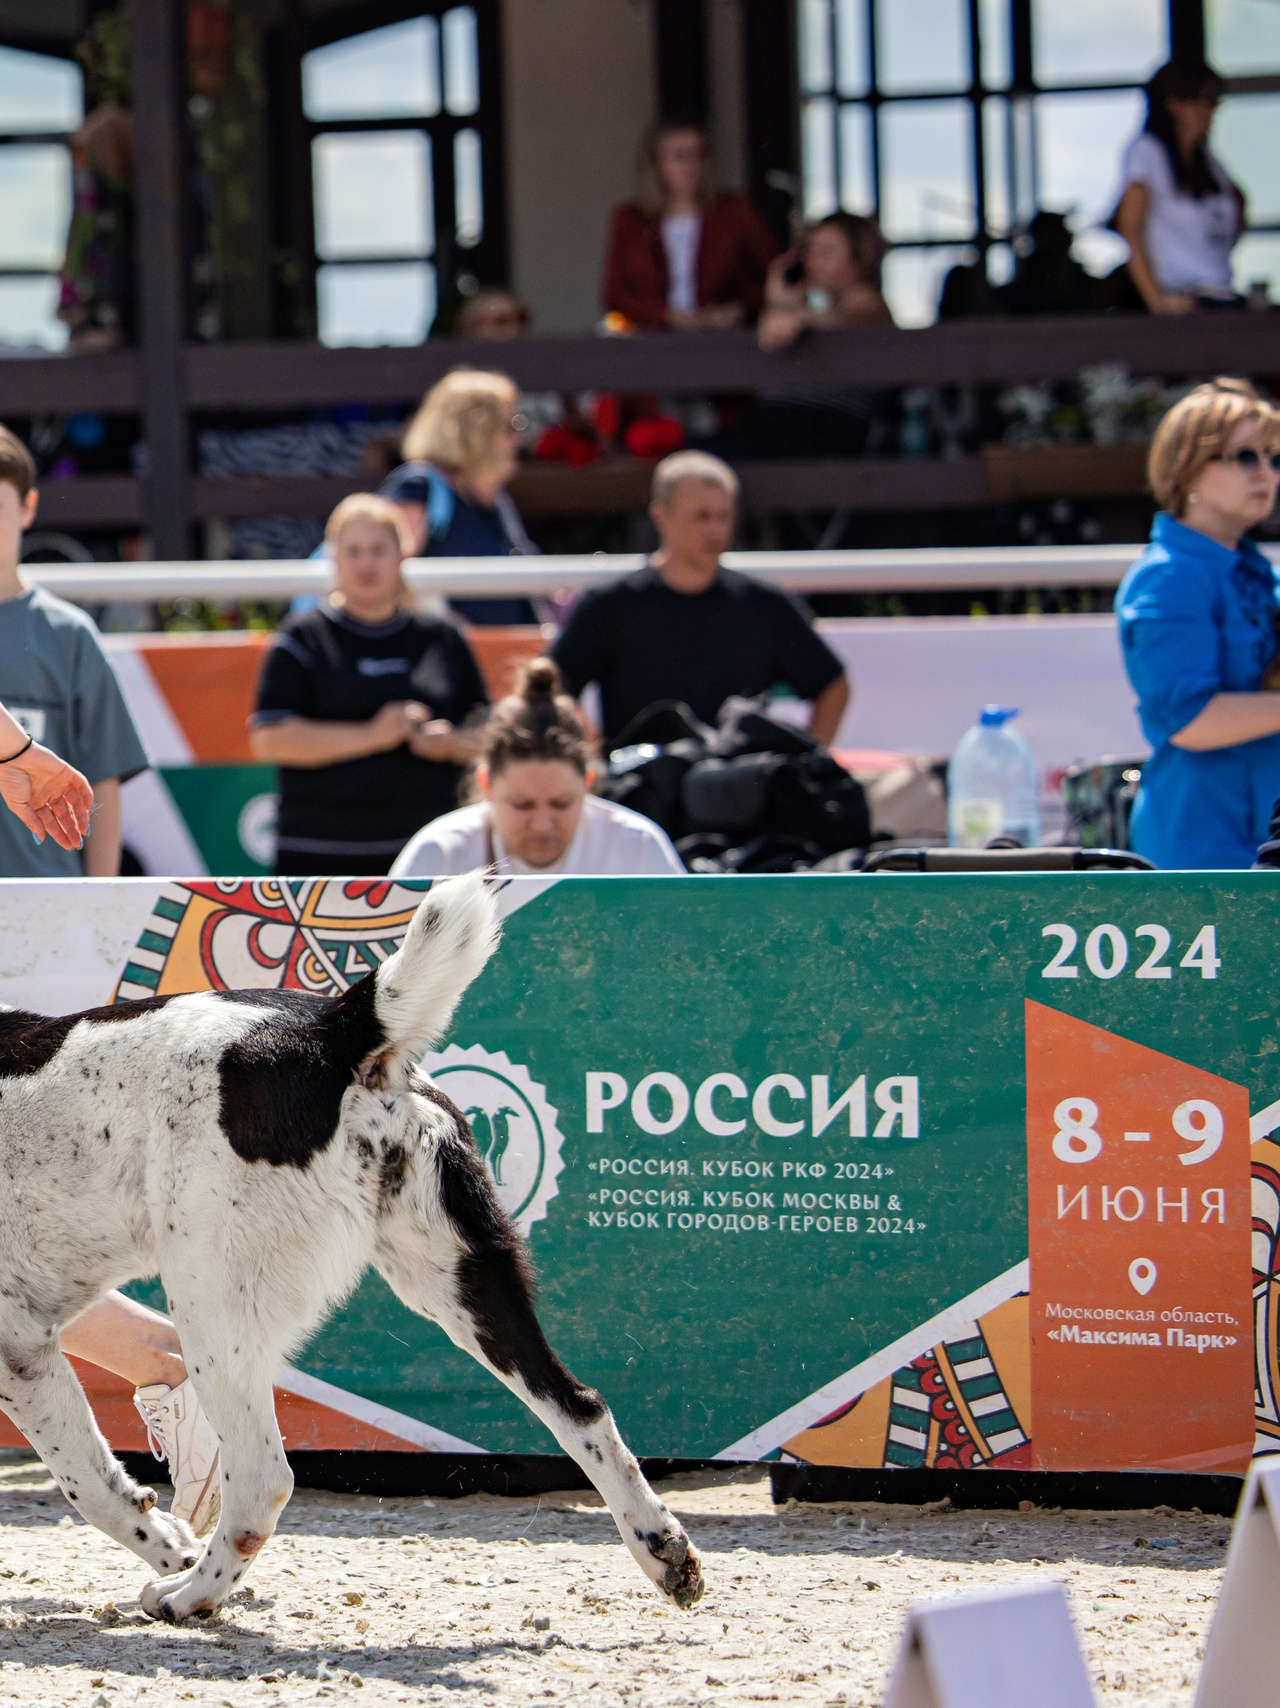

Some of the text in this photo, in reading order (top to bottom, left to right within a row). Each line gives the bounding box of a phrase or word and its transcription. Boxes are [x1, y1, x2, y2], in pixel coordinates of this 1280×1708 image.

[1041, 923, 1222, 980] 2024
[586, 1071, 920, 1139] РОССИЯ
[1052, 1096, 1103, 1164] 8
[1172, 1099, 1225, 1166] 9
[588, 1158, 895, 1180] «РОССИЯ. КУБОК РКФ 2024»
[588, 1189, 902, 1211] «РОССИЯ. КУБОК МОСКВЫ &
[1057, 1184, 1226, 1224] ИЮНЯ
[588, 1211, 927, 1234] КУБОК ГОРОДОВ-ГЕРОЕВ 2024»
[1045, 1303, 1239, 1326] Московская область,
[1046, 1324, 1238, 1354] «Максима Парк»
